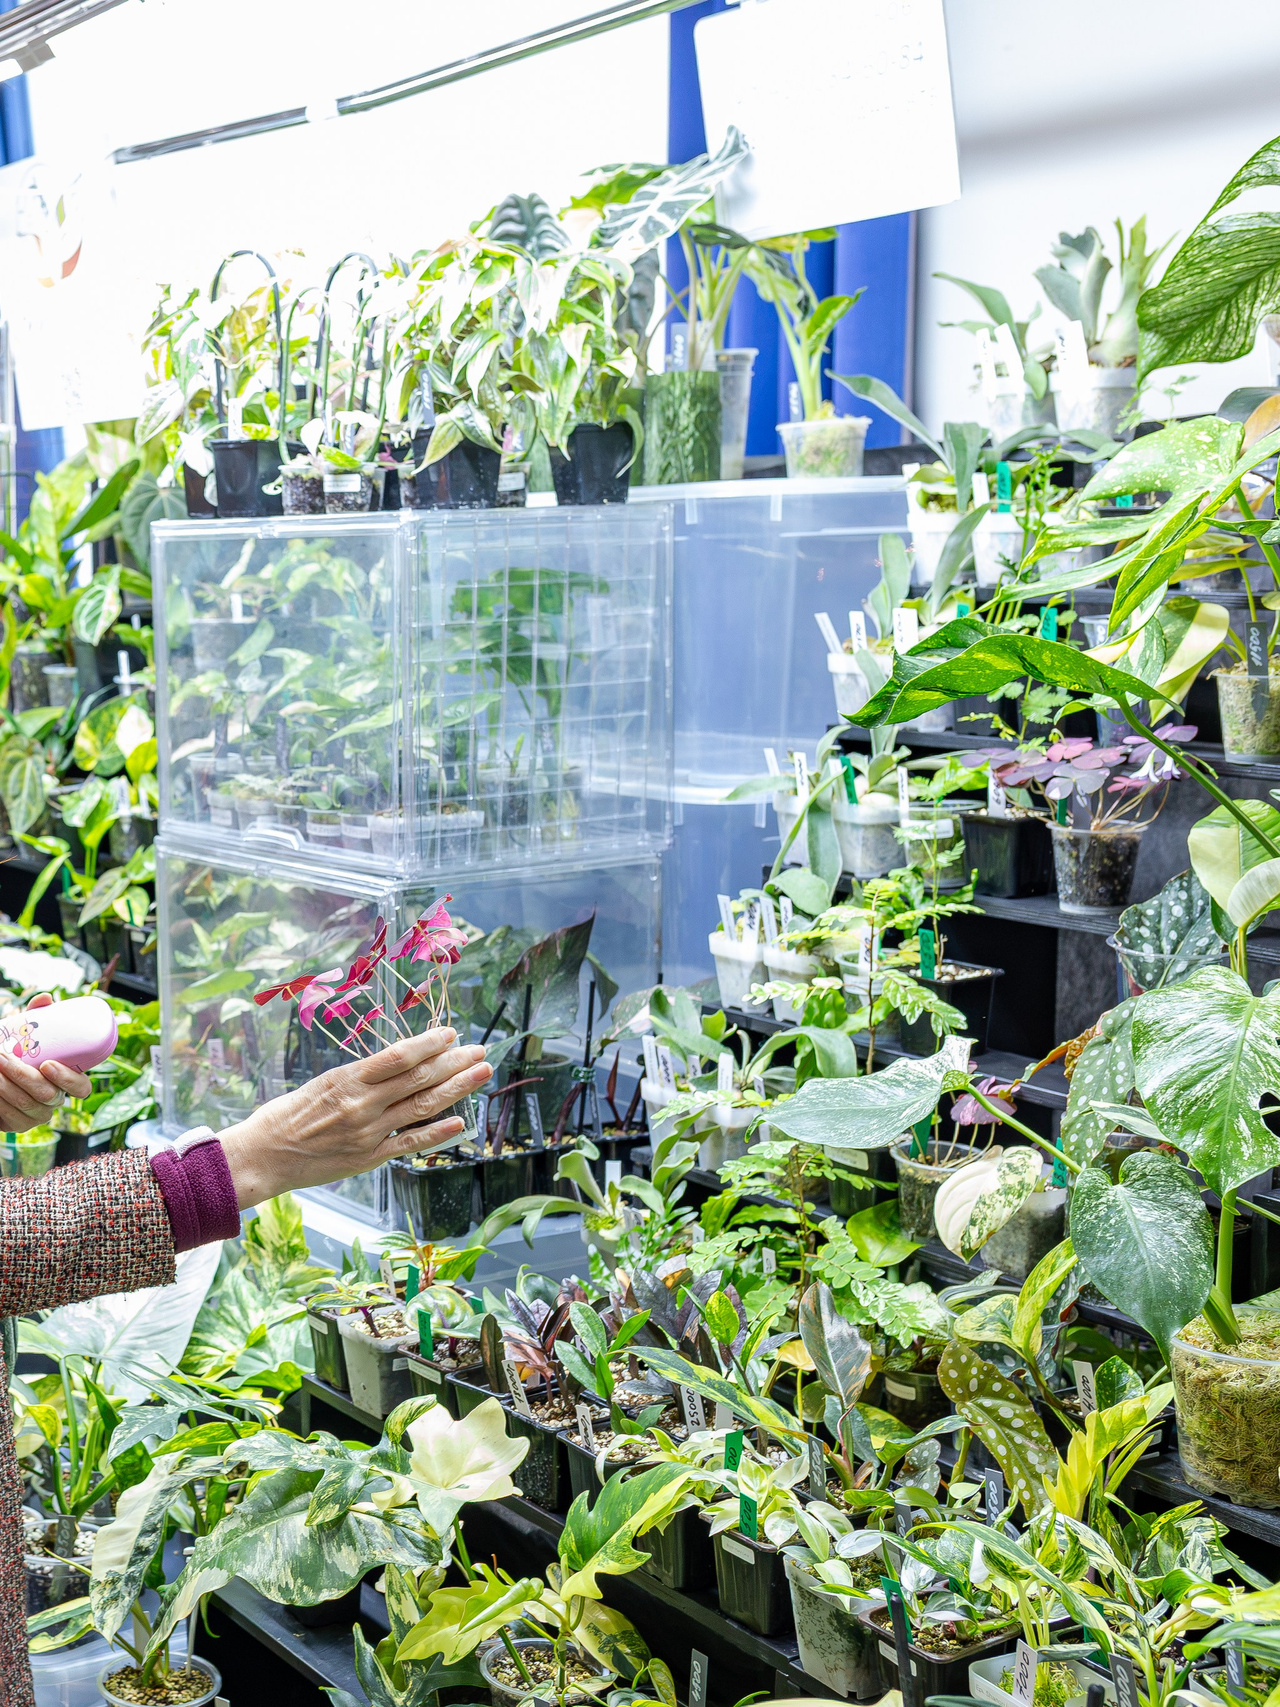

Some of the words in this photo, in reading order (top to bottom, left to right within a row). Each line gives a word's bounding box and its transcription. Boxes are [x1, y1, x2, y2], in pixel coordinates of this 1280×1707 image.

[1249, 627, 1263, 667] 11500
[686, 1387, 700, 1427] 25000
[691, 1660, 702, 1702] 4500
